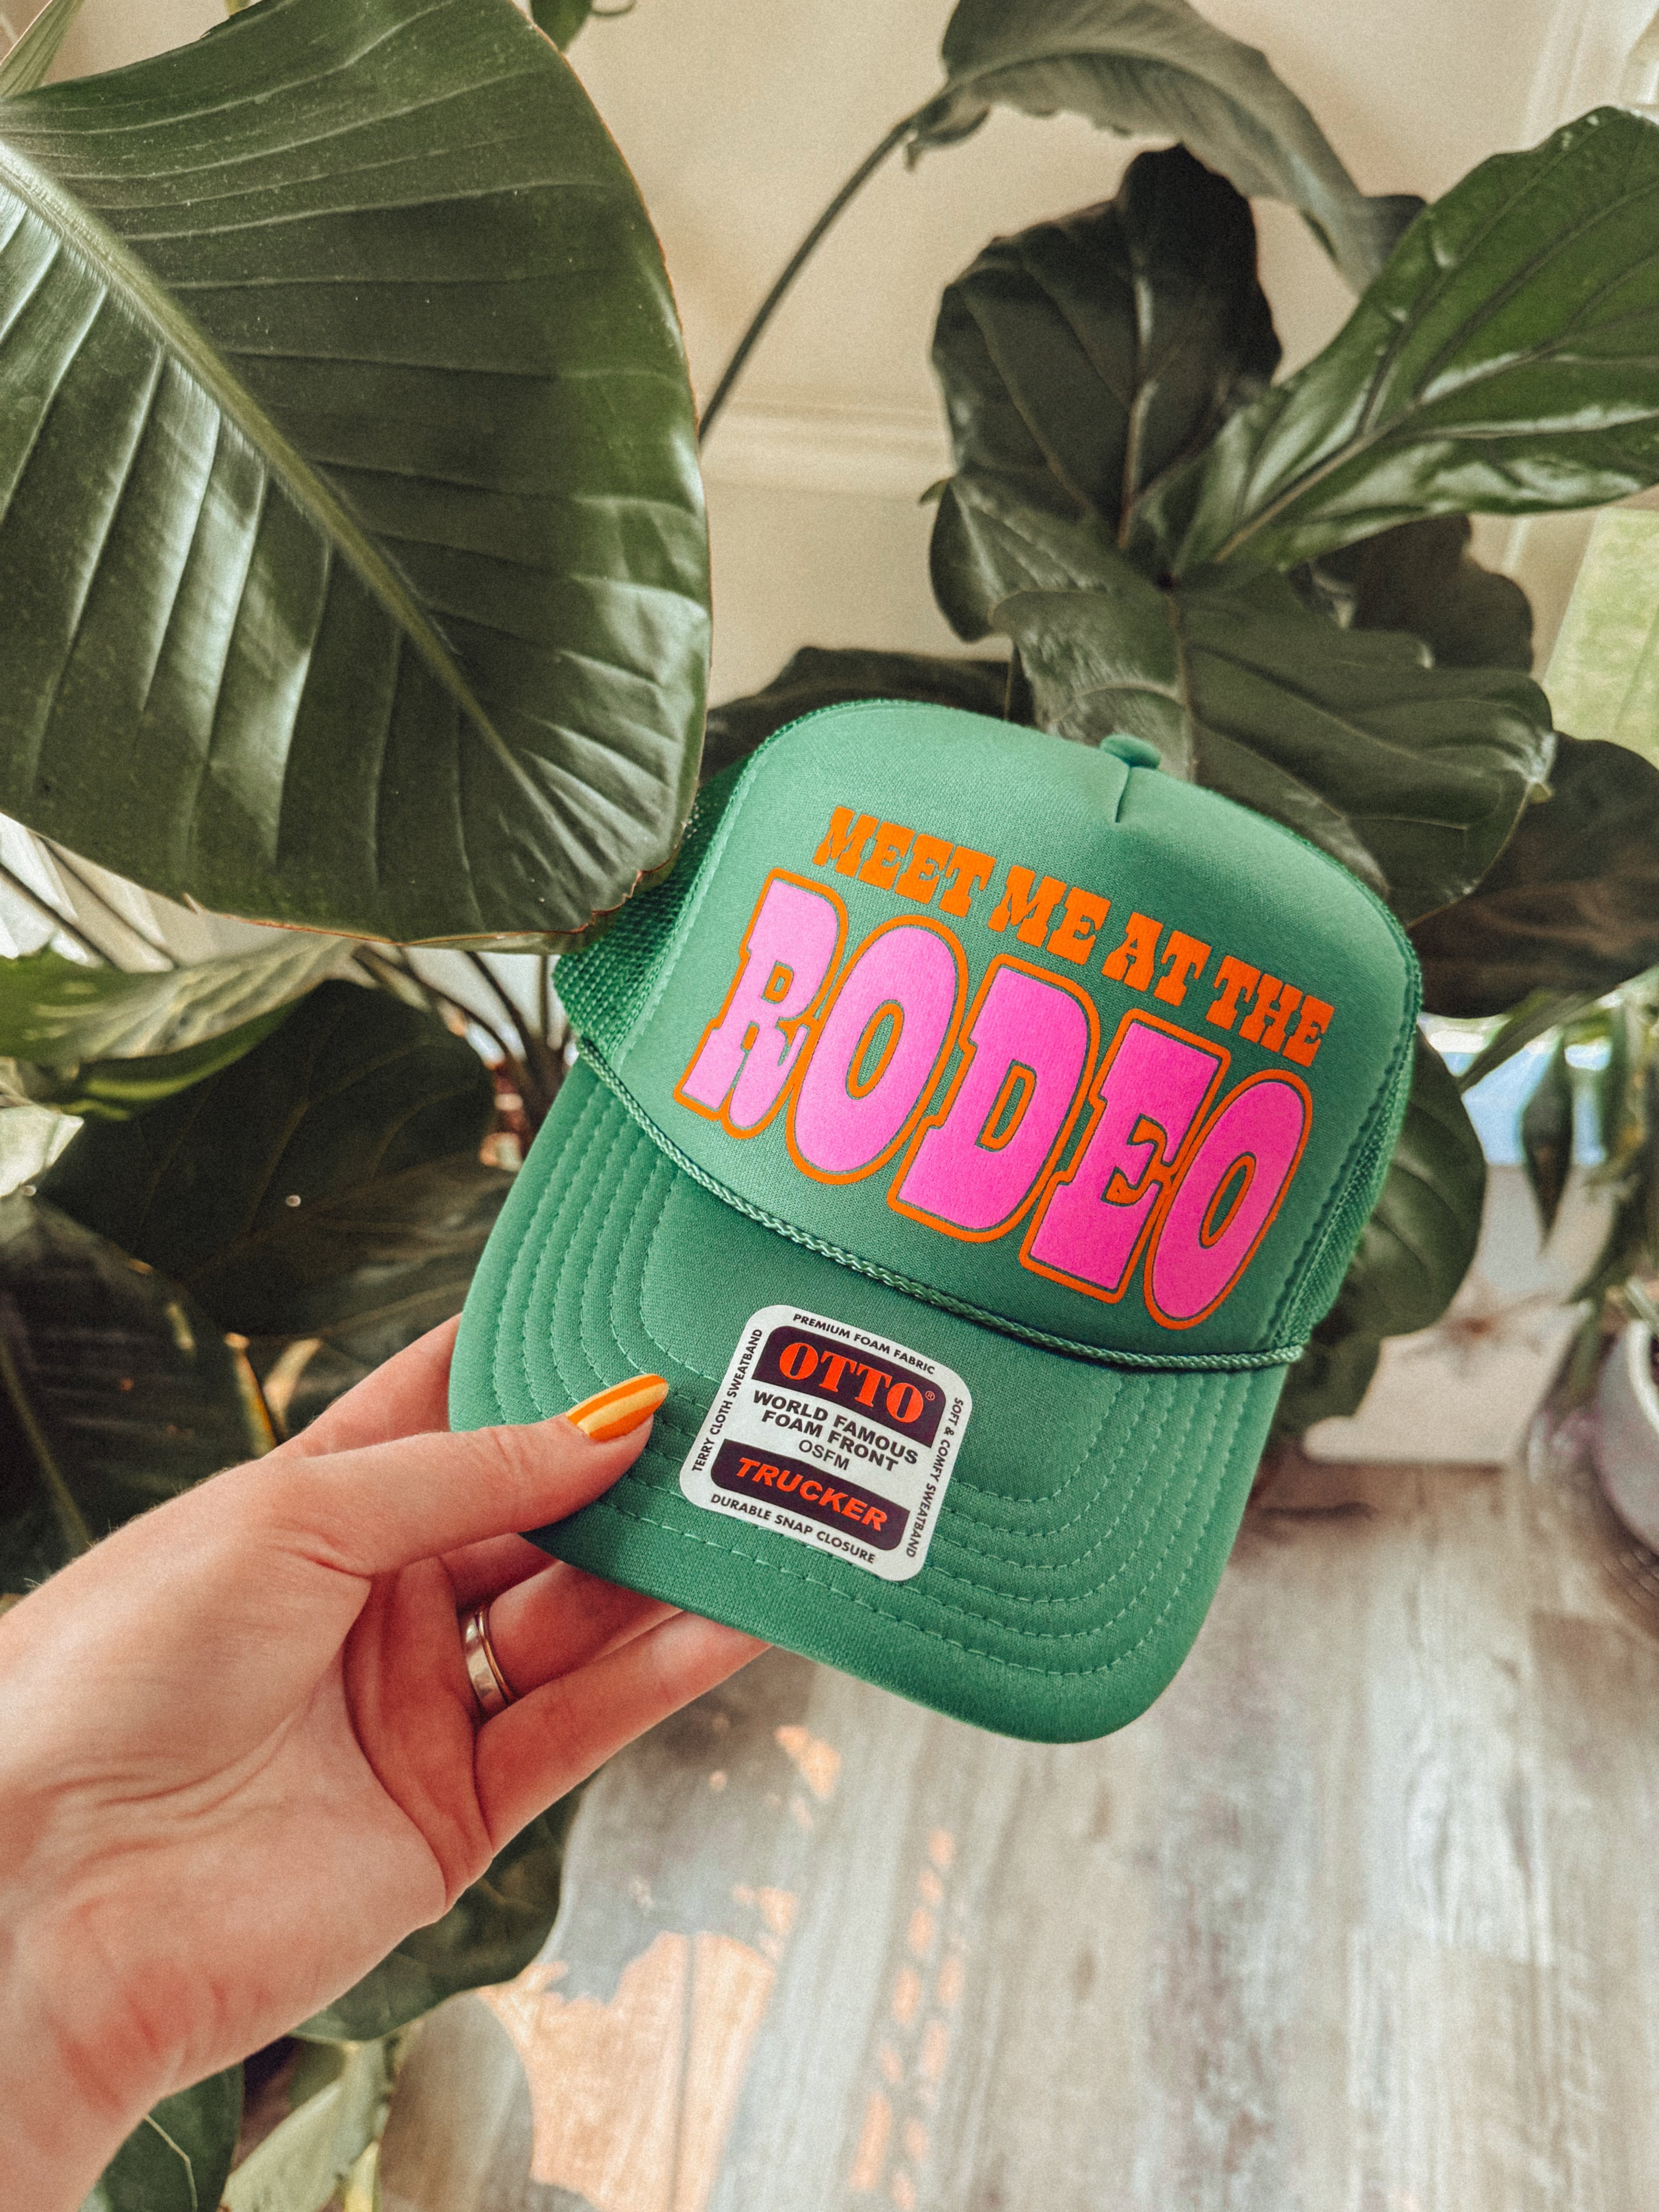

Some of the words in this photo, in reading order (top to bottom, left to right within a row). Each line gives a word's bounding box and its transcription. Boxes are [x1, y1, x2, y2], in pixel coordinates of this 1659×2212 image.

[814, 805, 996, 919] MEET
[988, 865, 1111, 967] ME
[1103, 912, 1211, 1005] AT
[1206, 955, 1335, 1067] THE
[673, 867, 1313, 1330] RODEO
[793, 1313, 850, 1339] PREMIUM
[854, 1334, 890, 1354] FOAM
[894, 1349, 935, 1375] FABRIC
[692, 1437, 715, 1472] TERRY
[710, 1401, 733, 1435] CLOTH
[727, 1329, 763, 1398] SWEATBAND
[753, 1390, 828, 1421] WORLD
[833, 1415, 918, 1465] FAMOUS
[947, 1397, 964, 1426] SOFT
[762, 1411, 822, 1439] FOAM
[827, 1431, 899, 1472] FRONT
[798, 1440, 850, 1470] OSFM
[933, 1439, 951, 1483] COMFY
[710, 1494, 771, 1520] DURABLE
[775, 1515, 813, 1535] SNAP
[817, 1531, 876, 1564] CLOSURE
[735, 1458, 887, 1532] TRUCKER
[906, 1484, 937, 1557] SWEATBAND
